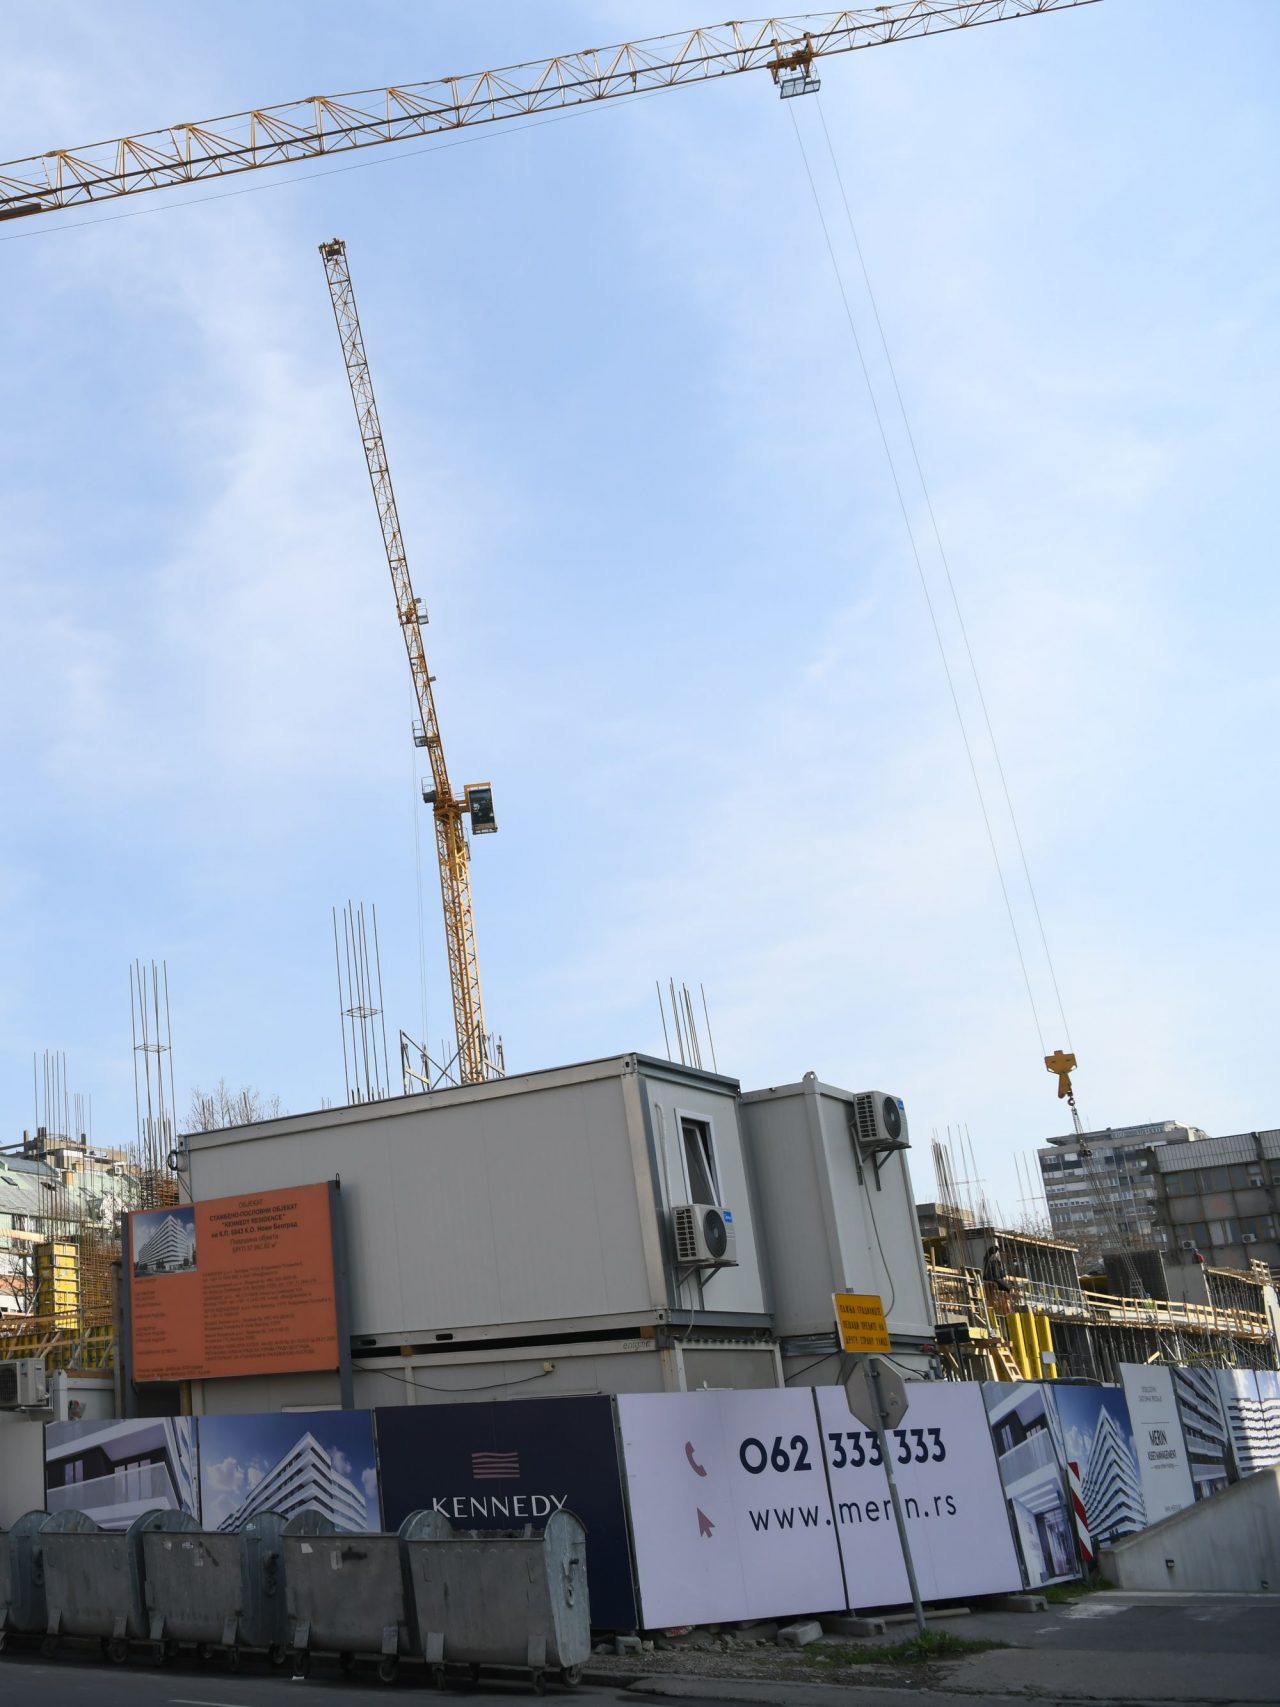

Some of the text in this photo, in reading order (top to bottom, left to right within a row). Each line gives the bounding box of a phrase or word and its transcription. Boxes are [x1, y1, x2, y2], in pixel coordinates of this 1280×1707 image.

[740, 1428, 946, 1474] 062 333 333
[1148, 1430, 1168, 1446] MERIN
[433, 1495, 568, 1518] KENNEDY
[749, 1495, 957, 1531] www.mern.rs
